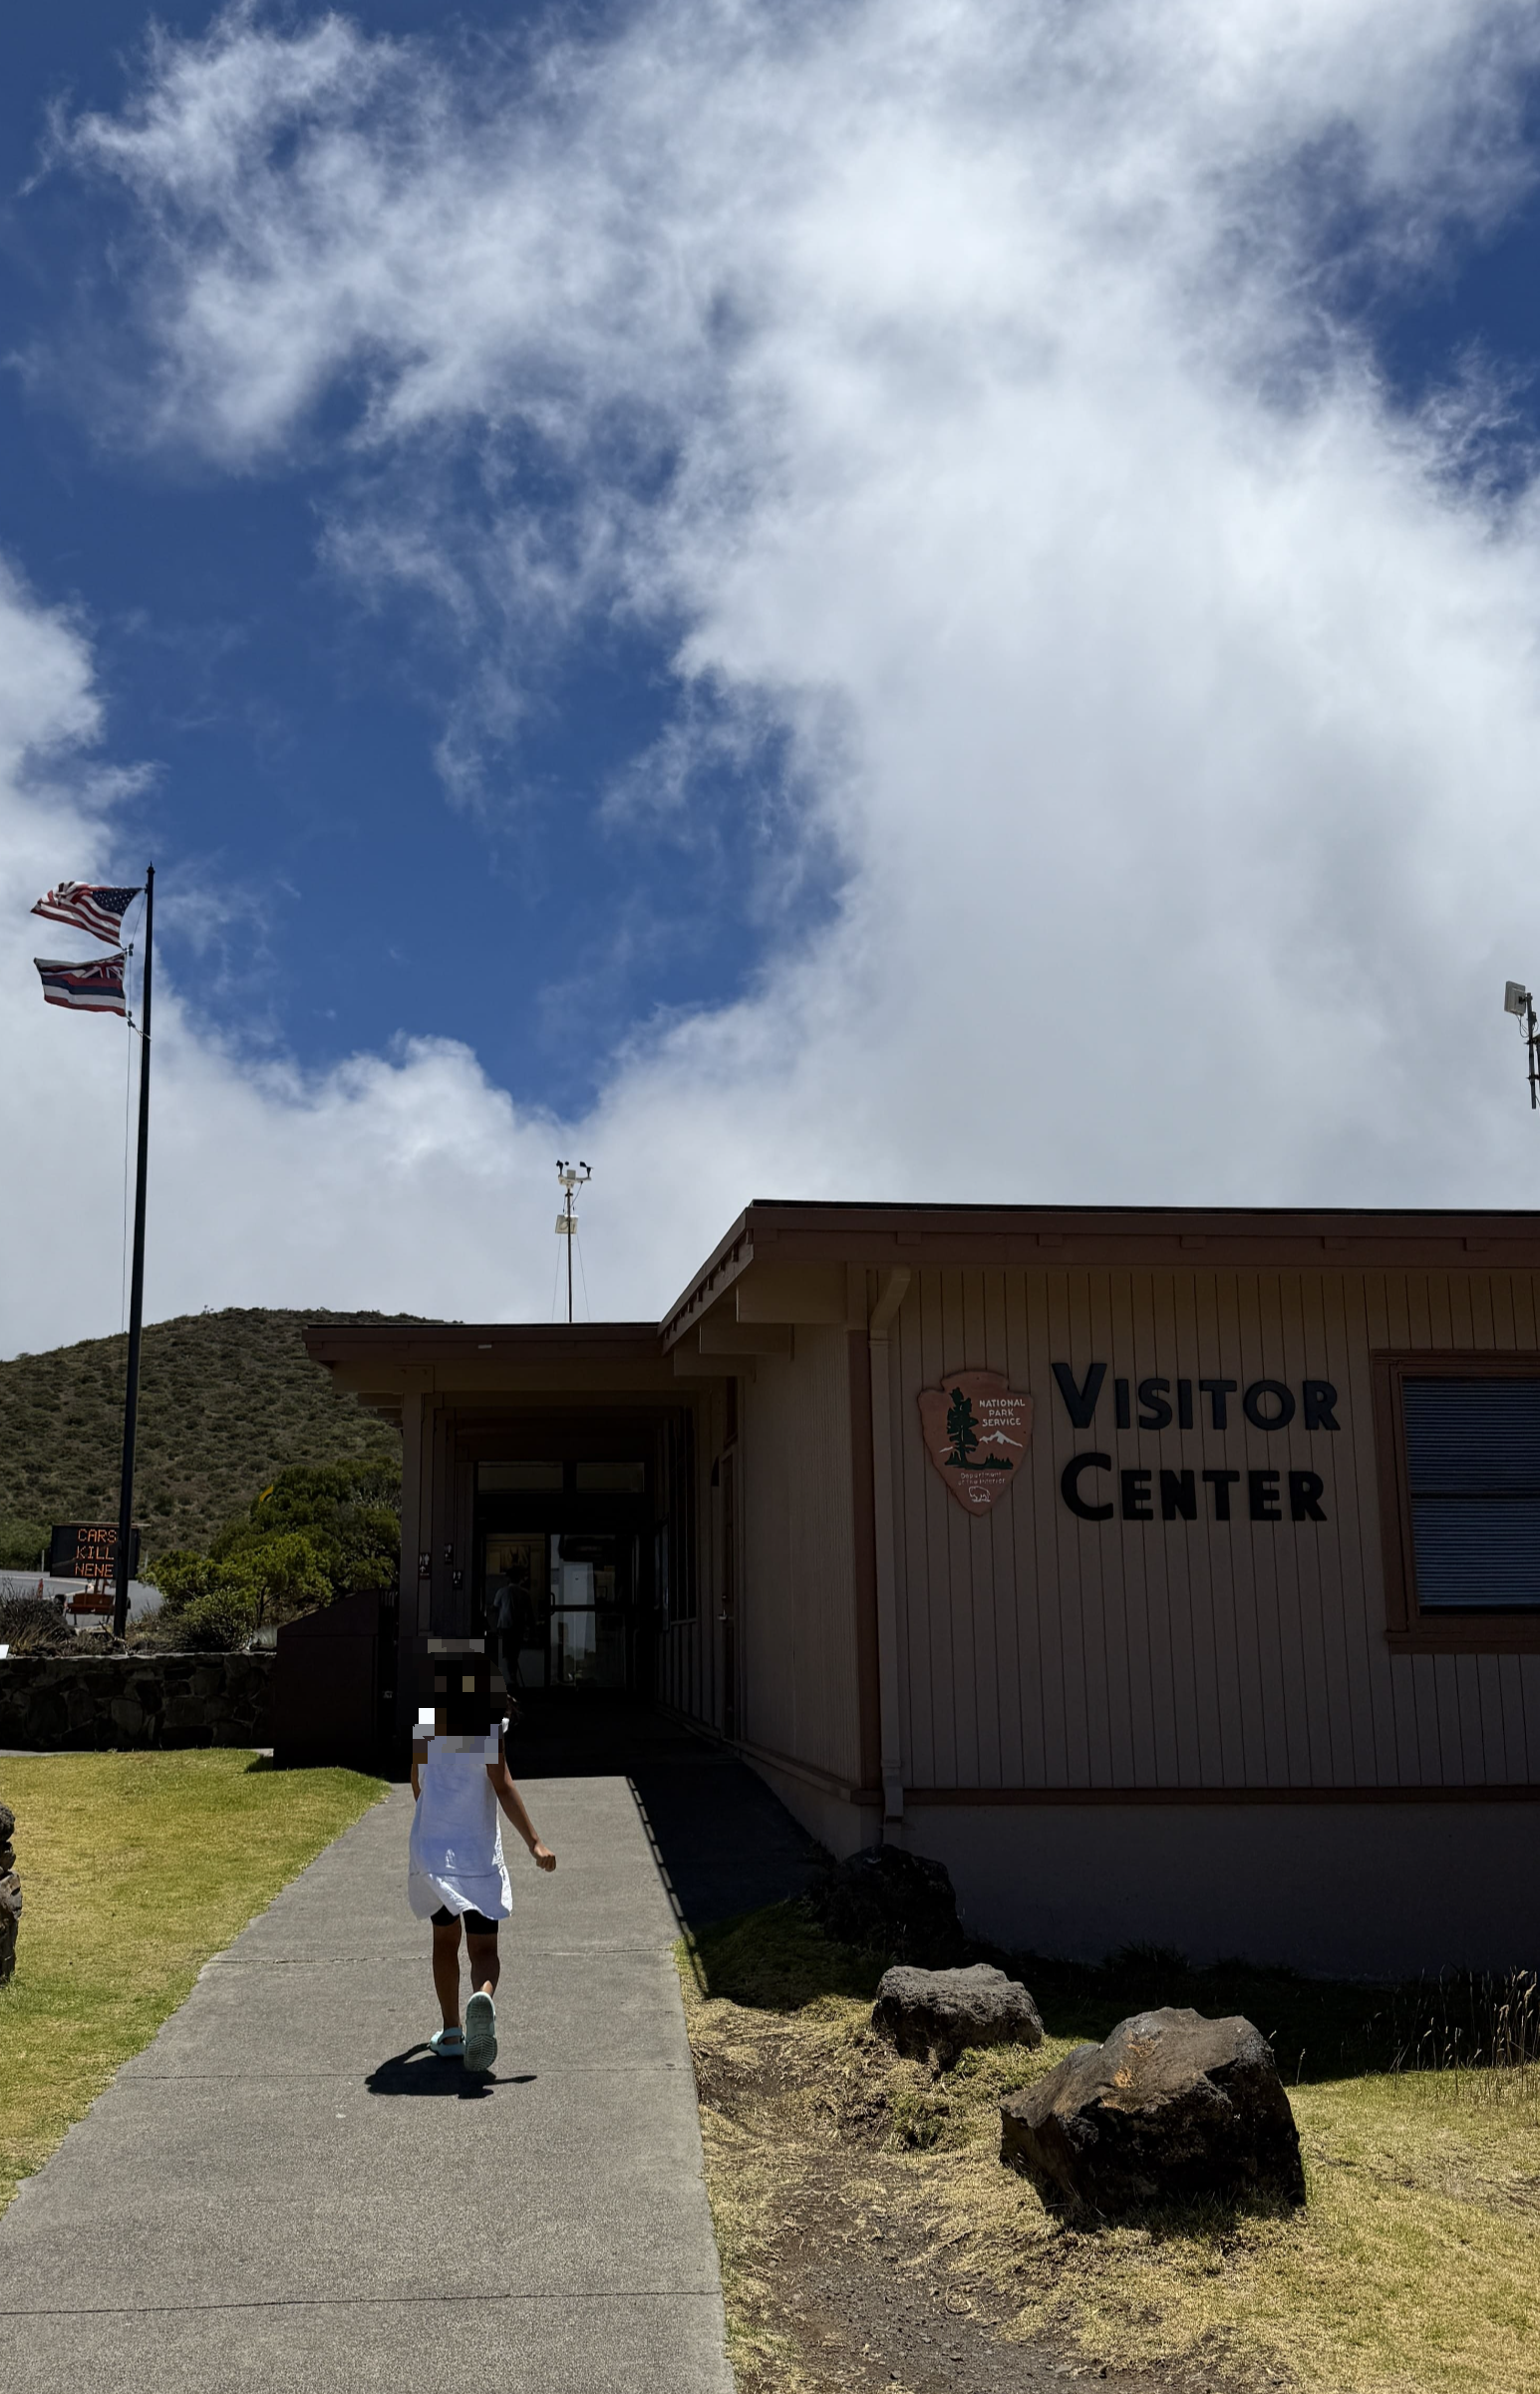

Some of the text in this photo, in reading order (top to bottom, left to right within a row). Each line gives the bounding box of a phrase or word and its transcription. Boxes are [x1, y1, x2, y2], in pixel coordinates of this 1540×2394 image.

[979, 1399, 1025, 1408] NATIONAL
[1051, 1362, 1342, 1432] VISITOR
[989, 1408, 1014, 1417] PARK
[982, 1418, 1022, 1427] SERVICE
[1061, 1452, 1328, 1522] CENTER
[78, 1529, 118, 1543] CARS
[76, 1545, 115, 1560] KILL
[75, 1562, 115, 1577] NENE
